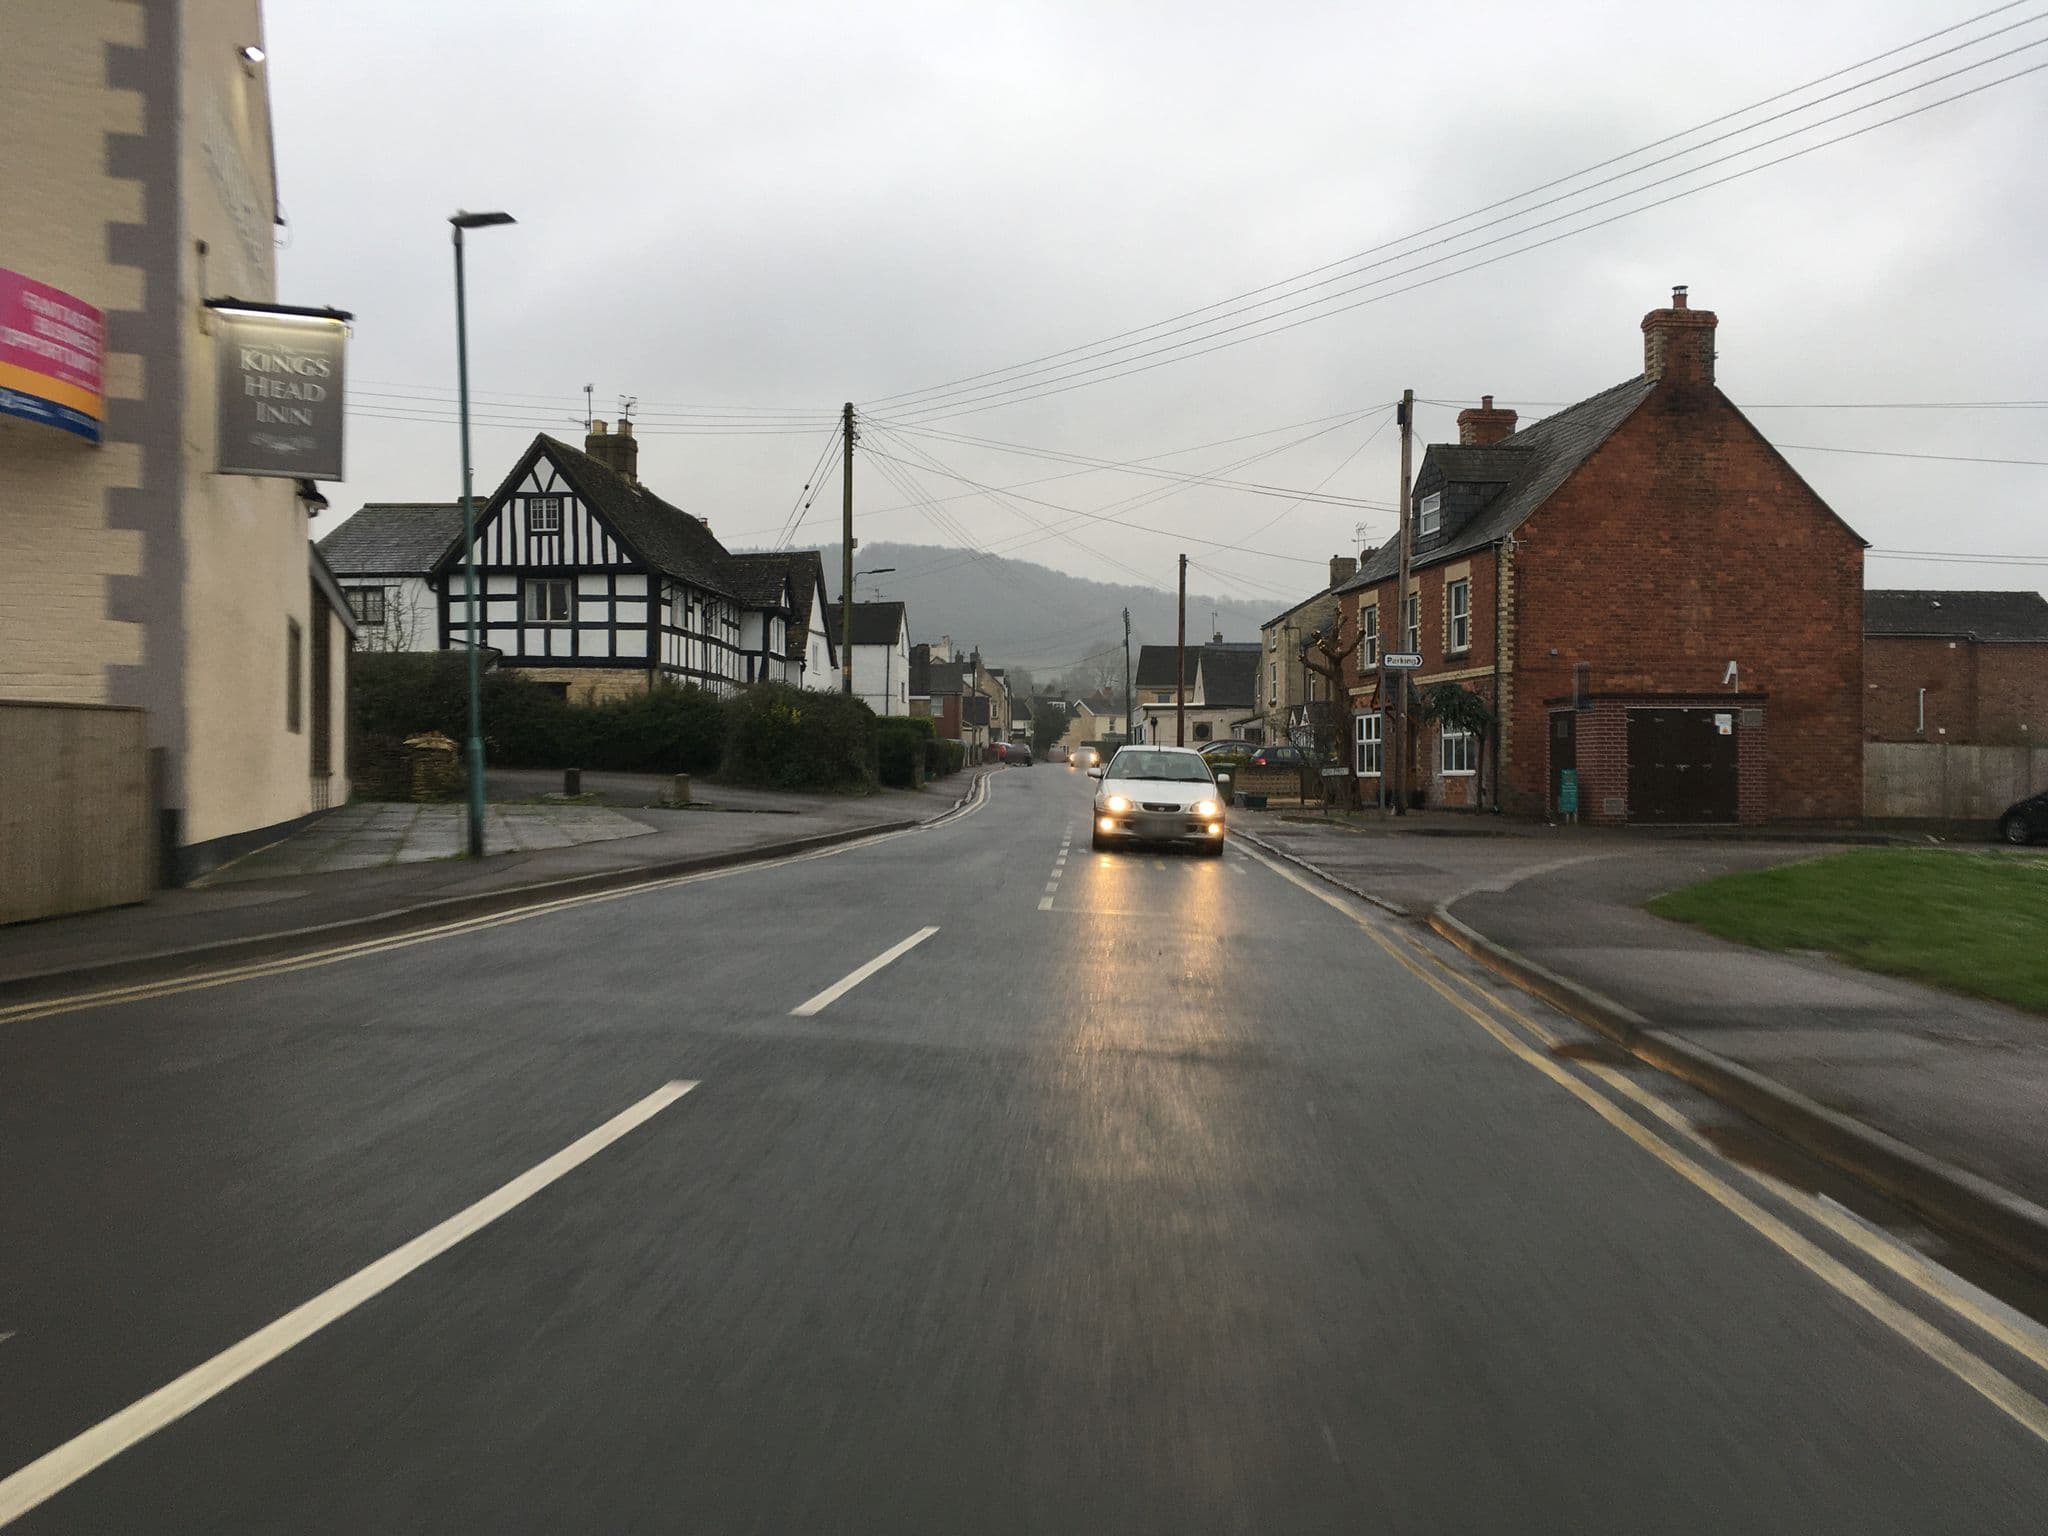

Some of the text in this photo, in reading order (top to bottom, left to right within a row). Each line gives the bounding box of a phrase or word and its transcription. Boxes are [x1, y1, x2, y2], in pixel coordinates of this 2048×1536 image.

[240, 349, 330, 378] KINGS
[244, 375, 327, 402] HEAD
[256, 401, 312, 426] INN
[1387, 656, 1417, 665] Parking
